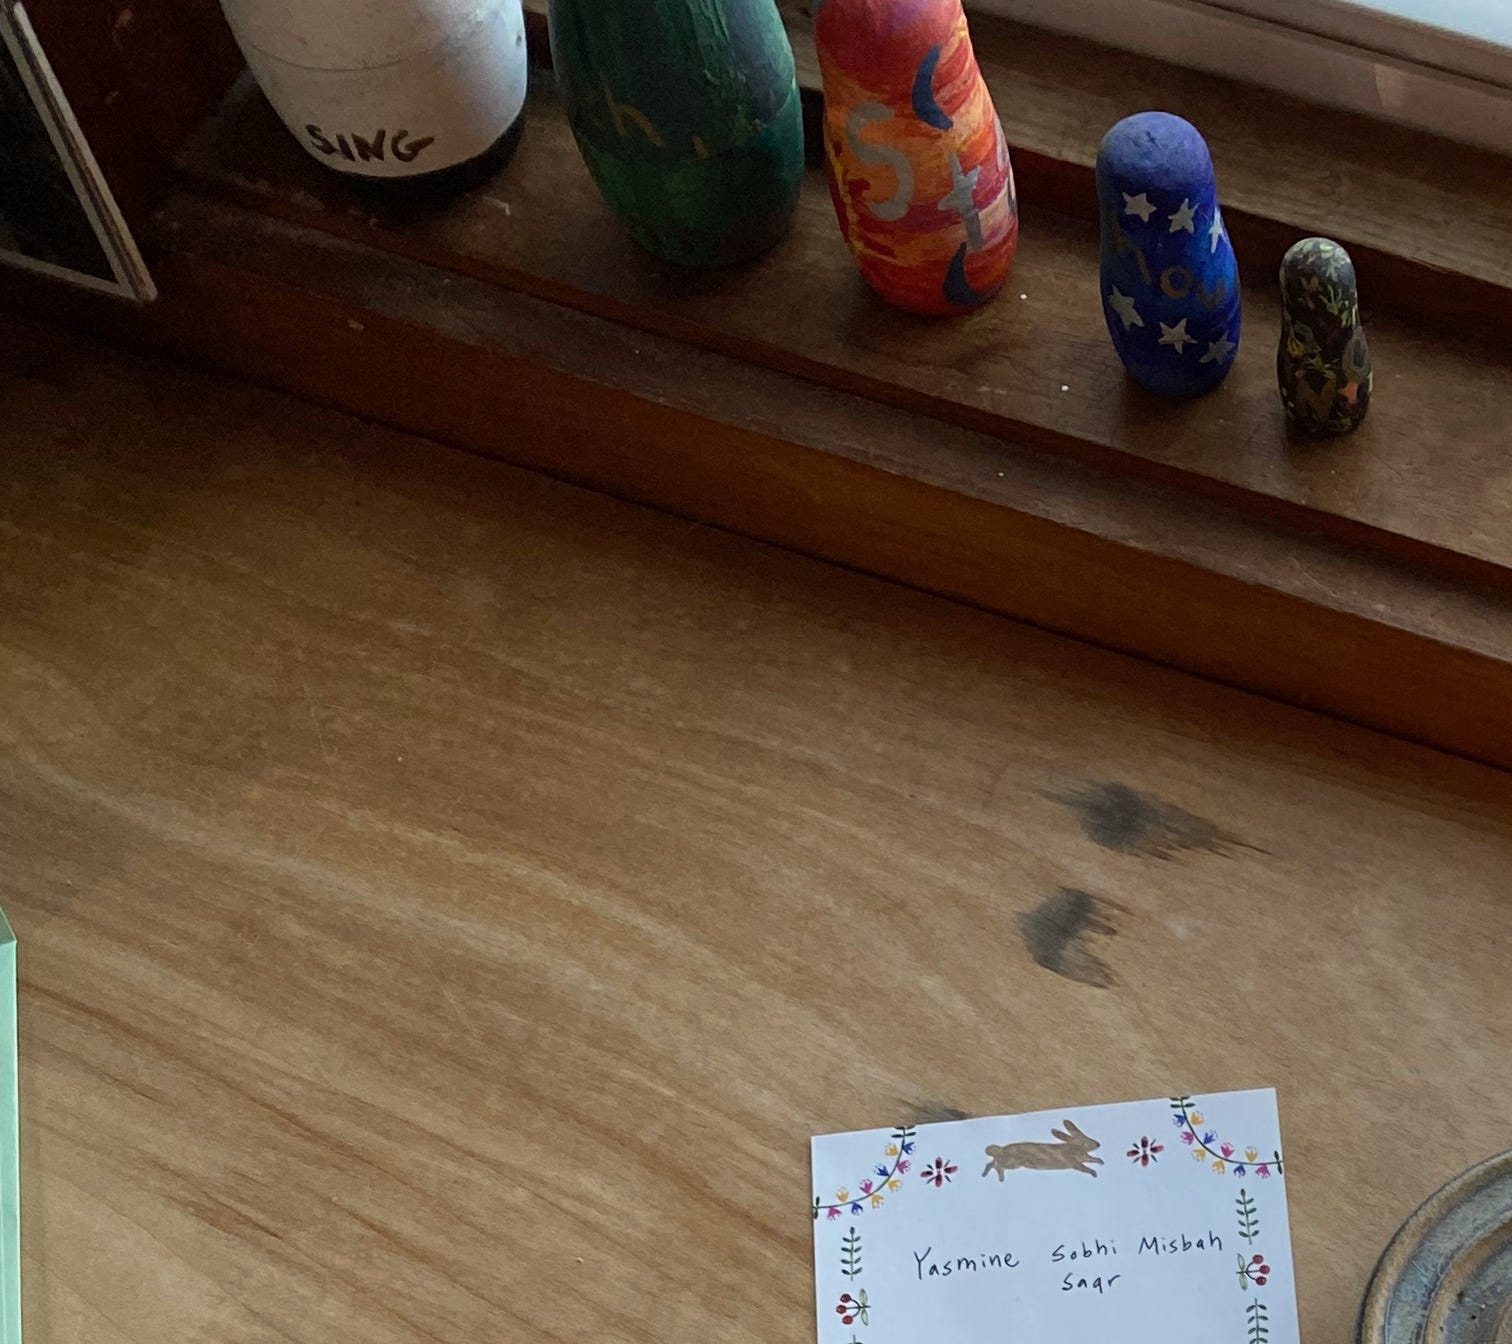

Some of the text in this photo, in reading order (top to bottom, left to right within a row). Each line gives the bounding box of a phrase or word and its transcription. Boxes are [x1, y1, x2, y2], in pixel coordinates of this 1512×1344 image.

[304, 121, 434, 163] SING
[913, 1229, 1223, 1281] Yasmine Sobhi Misbah
